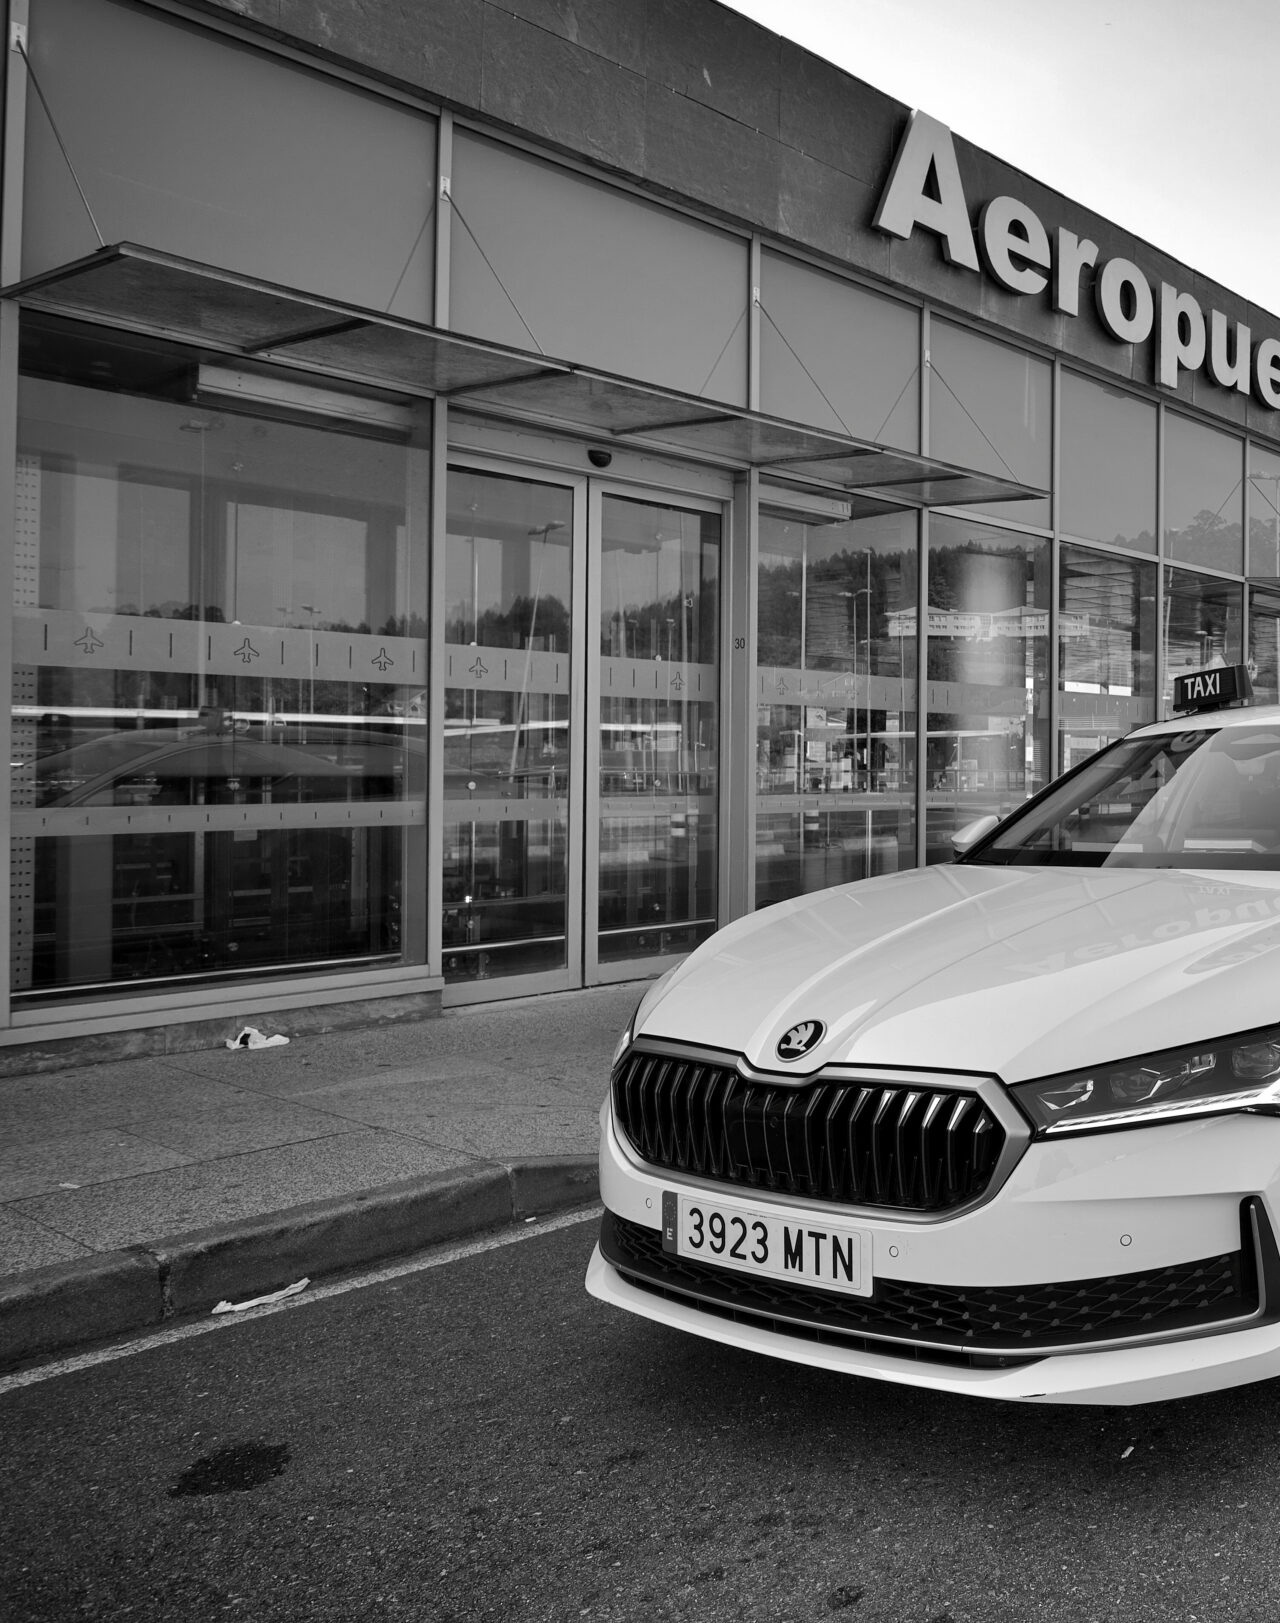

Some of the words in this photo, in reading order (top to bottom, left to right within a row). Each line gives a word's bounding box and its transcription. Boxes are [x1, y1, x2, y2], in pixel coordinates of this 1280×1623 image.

[734, 637, 745, 649] 30
[1184, 672, 1220, 699] TAXI
[666, 1227, 674, 1241] E
[688, 1207, 769, 1264] 3923
[783, 1226, 853, 1282] MTN
